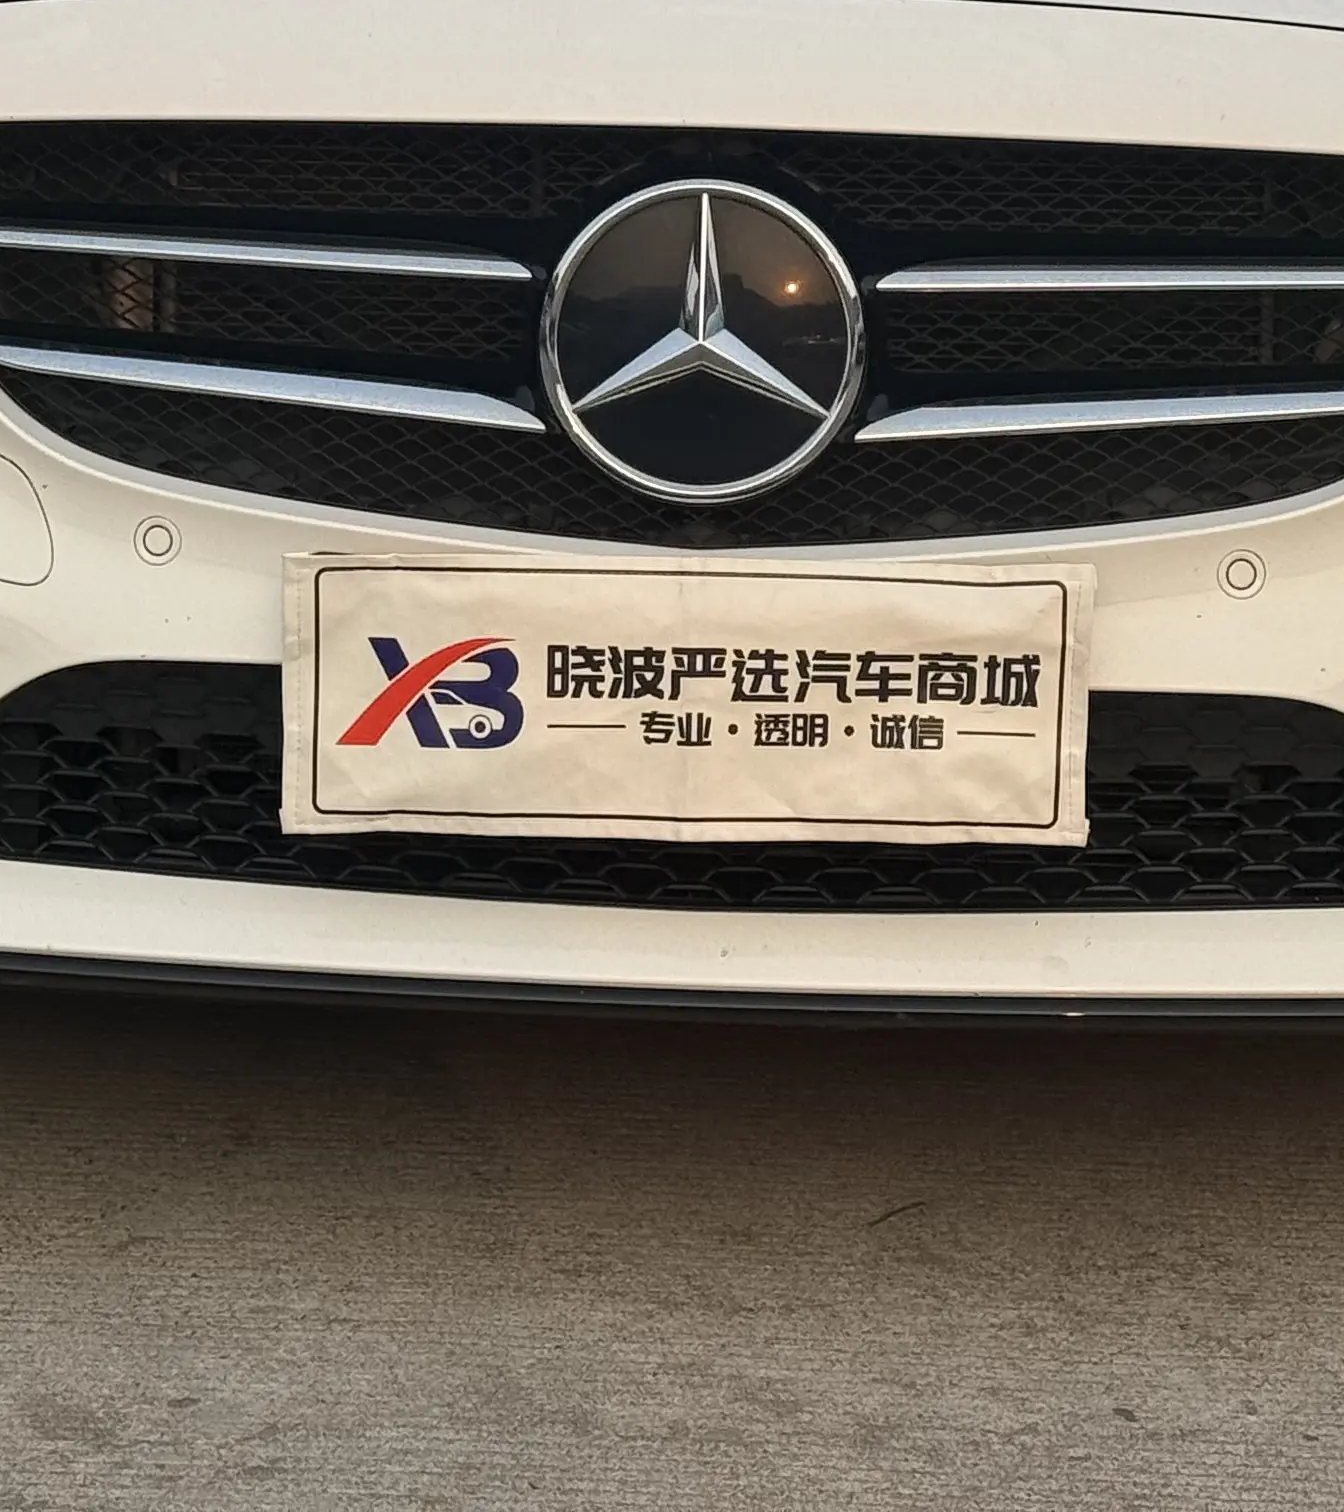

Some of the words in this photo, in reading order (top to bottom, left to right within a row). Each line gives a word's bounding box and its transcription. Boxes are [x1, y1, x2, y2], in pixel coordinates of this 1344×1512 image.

[546, 644, 1041, 708] 晓波严选汽车商城
